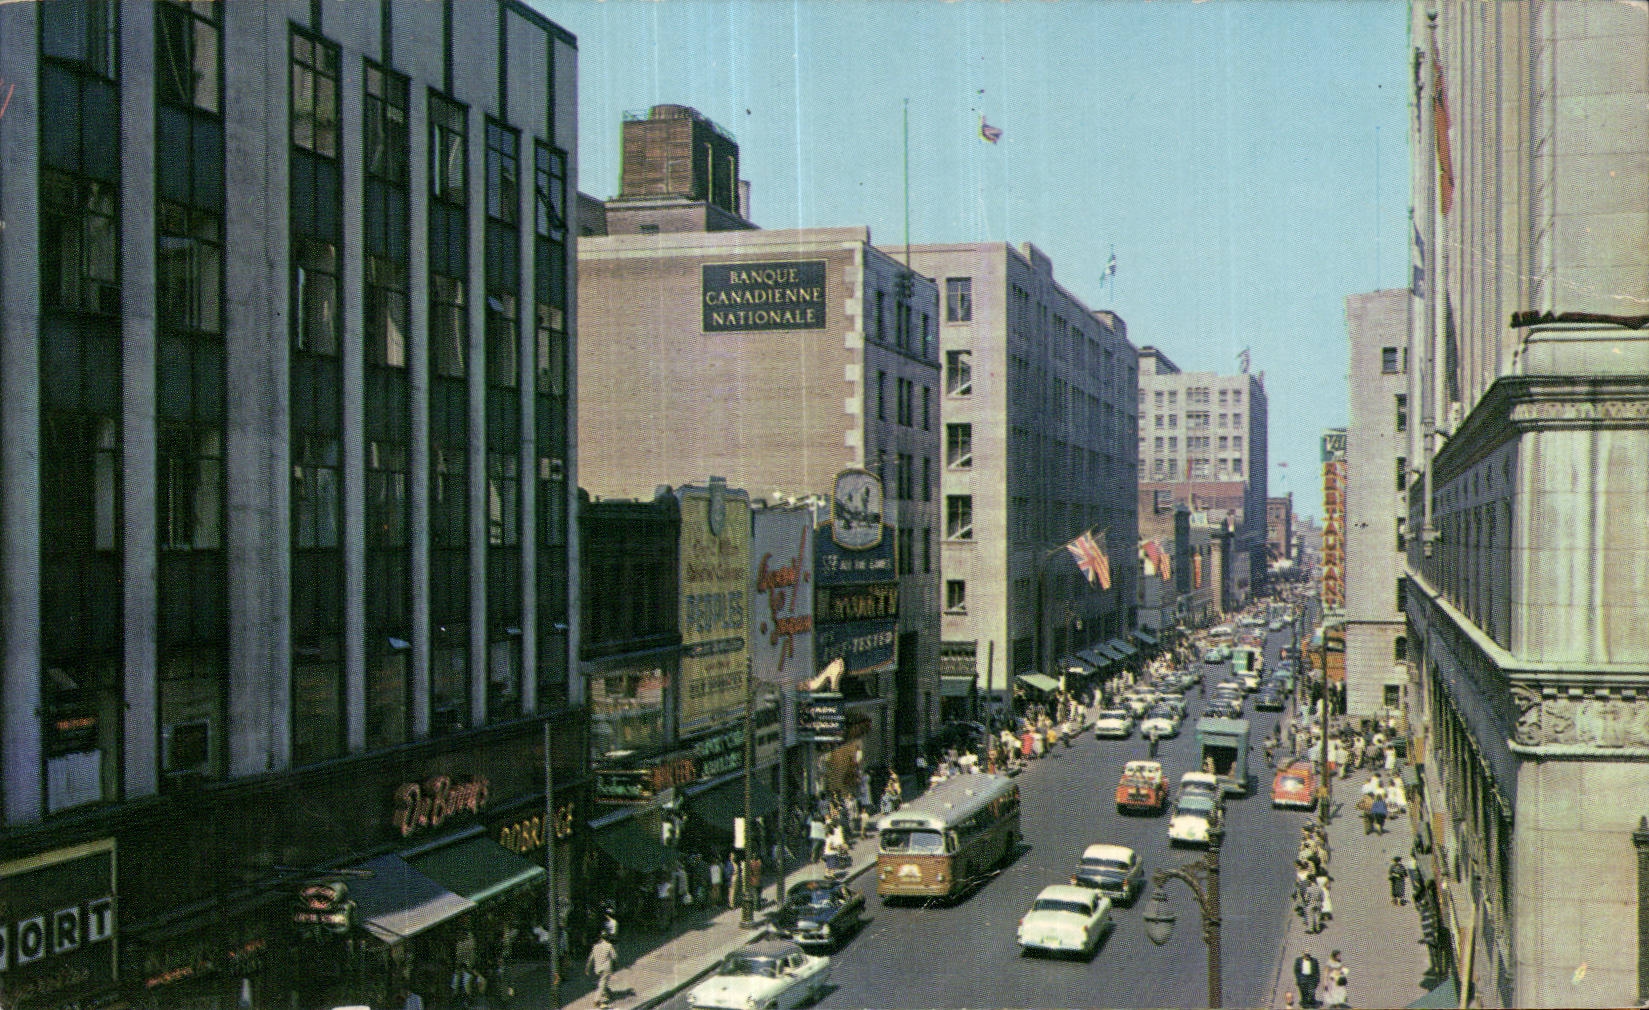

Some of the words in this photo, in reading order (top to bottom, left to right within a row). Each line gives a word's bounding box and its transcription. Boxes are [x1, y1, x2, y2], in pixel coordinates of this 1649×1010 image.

[728, 268, 799, 285] BANQUE
[705, 288, 821, 305] CANADIENNE
[711, 308, 816, 326] NATIONALE
[1322, 462, 1339, 611] RESTAURANT
[0, 901, 111, 958] ORT
